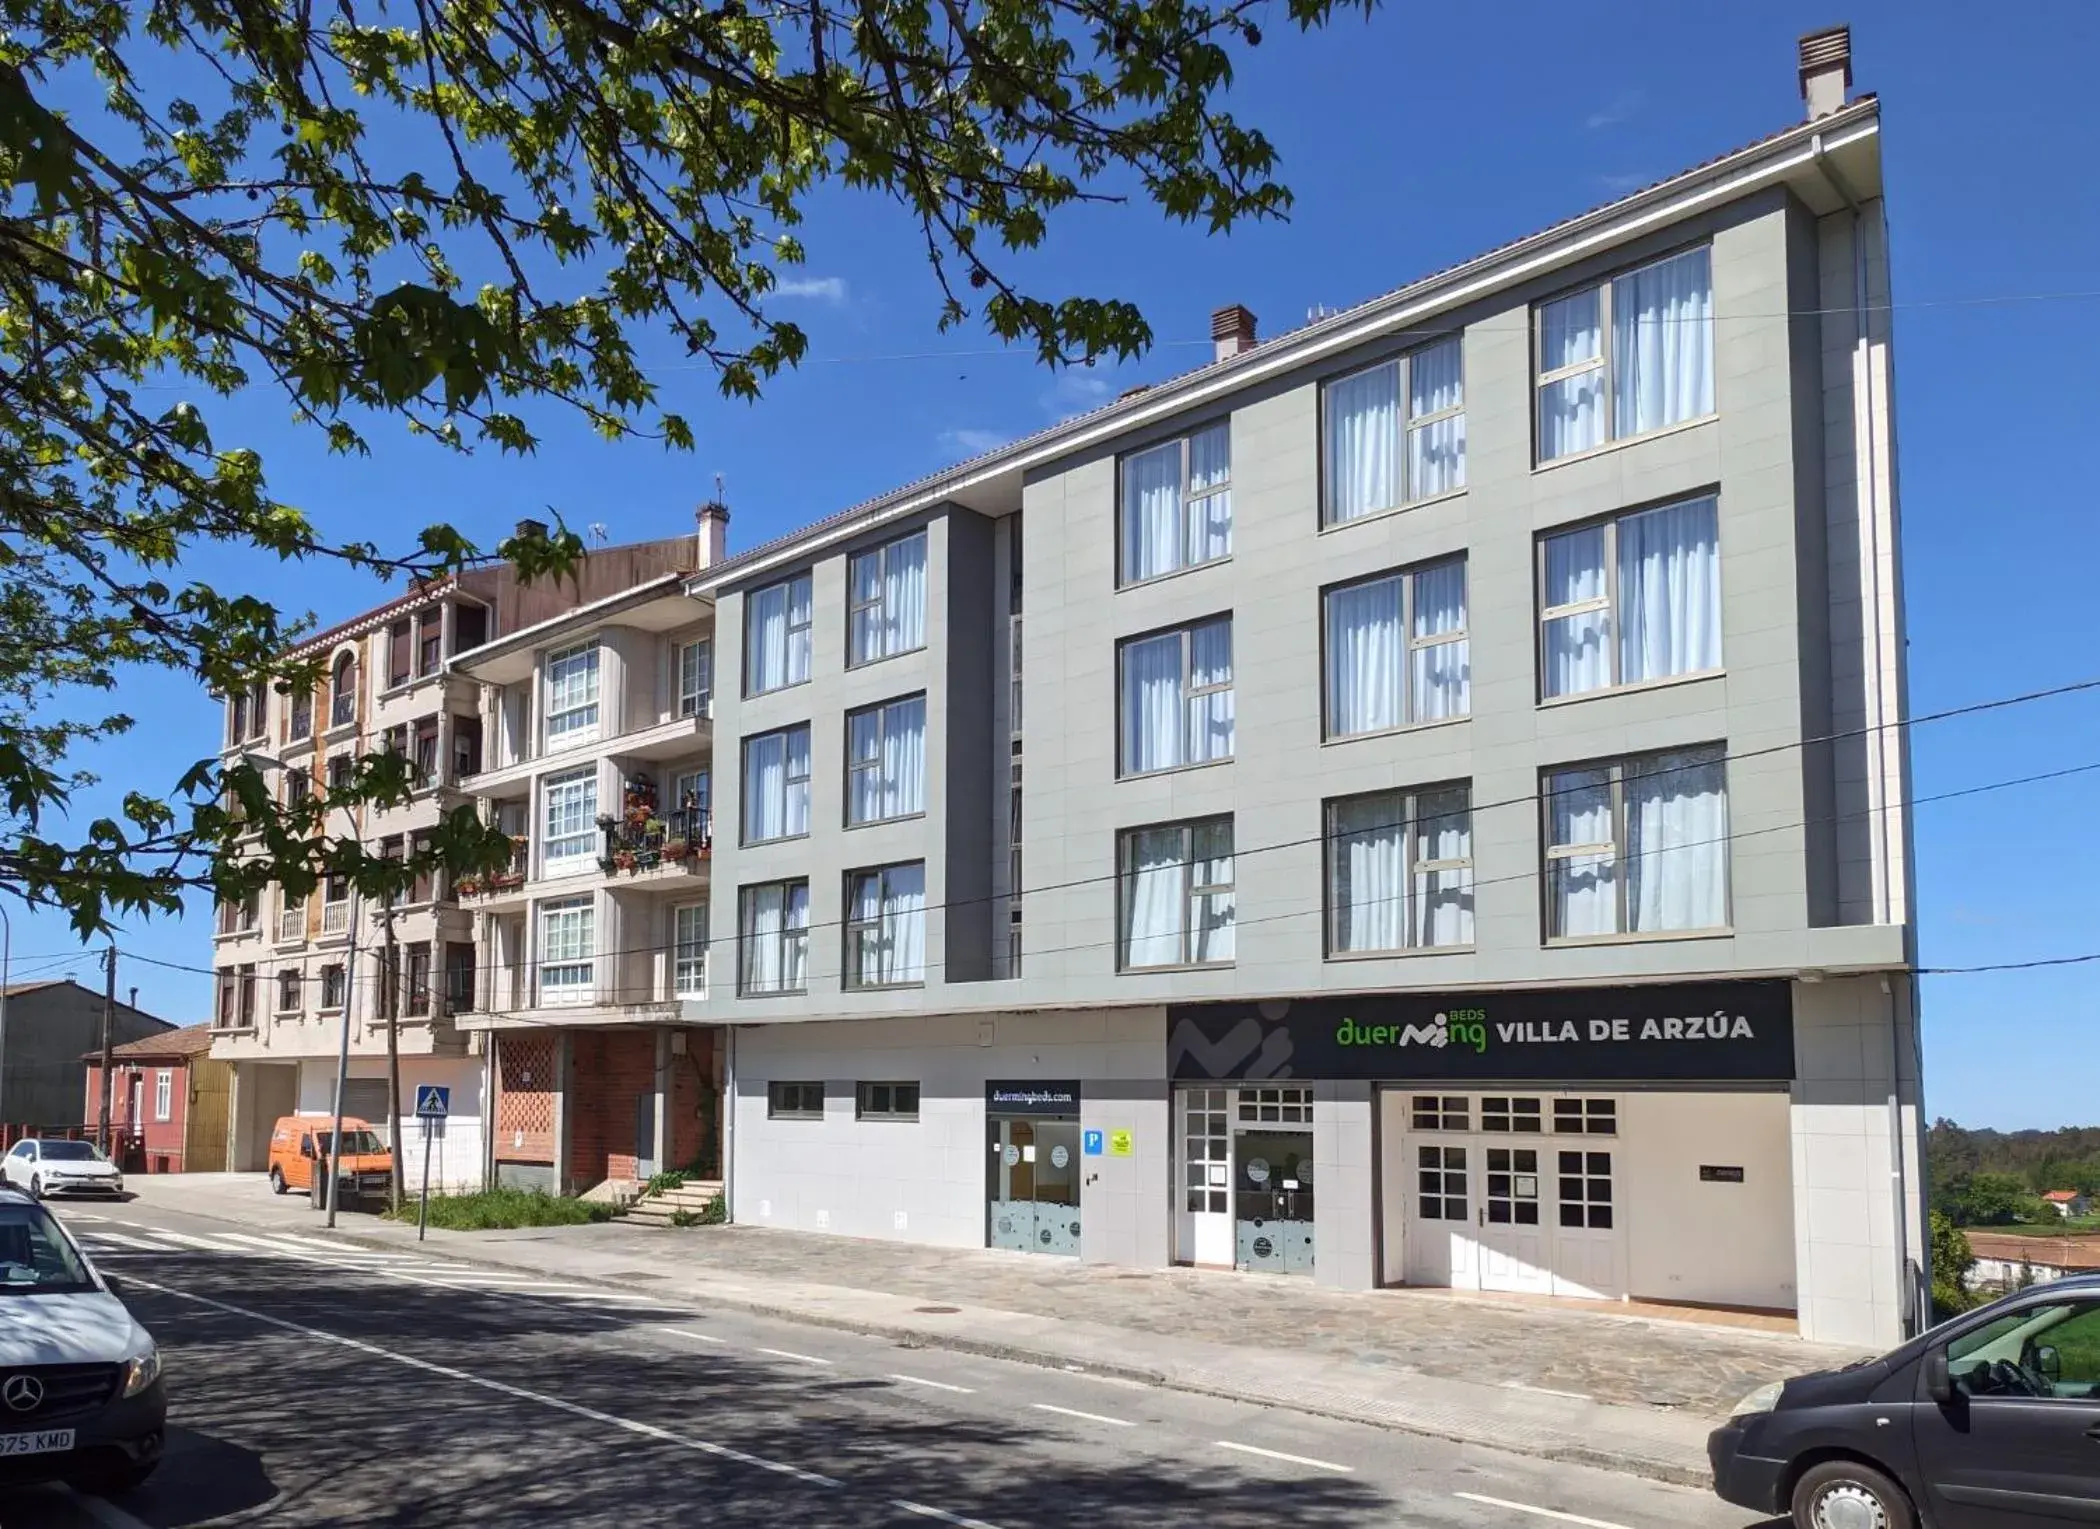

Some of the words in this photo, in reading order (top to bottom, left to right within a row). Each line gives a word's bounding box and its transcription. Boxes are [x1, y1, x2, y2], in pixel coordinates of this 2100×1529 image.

[1449, 1009, 1486, 1021] BEDS
[1496, 1020, 1580, 1043] VILLA
[1588, 1018, 1631, 1041] DE
[1639, 1010, 1754, 1040] ARZÚA
[993, 1089, 1072, 1105] duermingbeds.com
[1088, 1133, 1099, 1148] P
[36, 1432, 70, 1450] KMD
